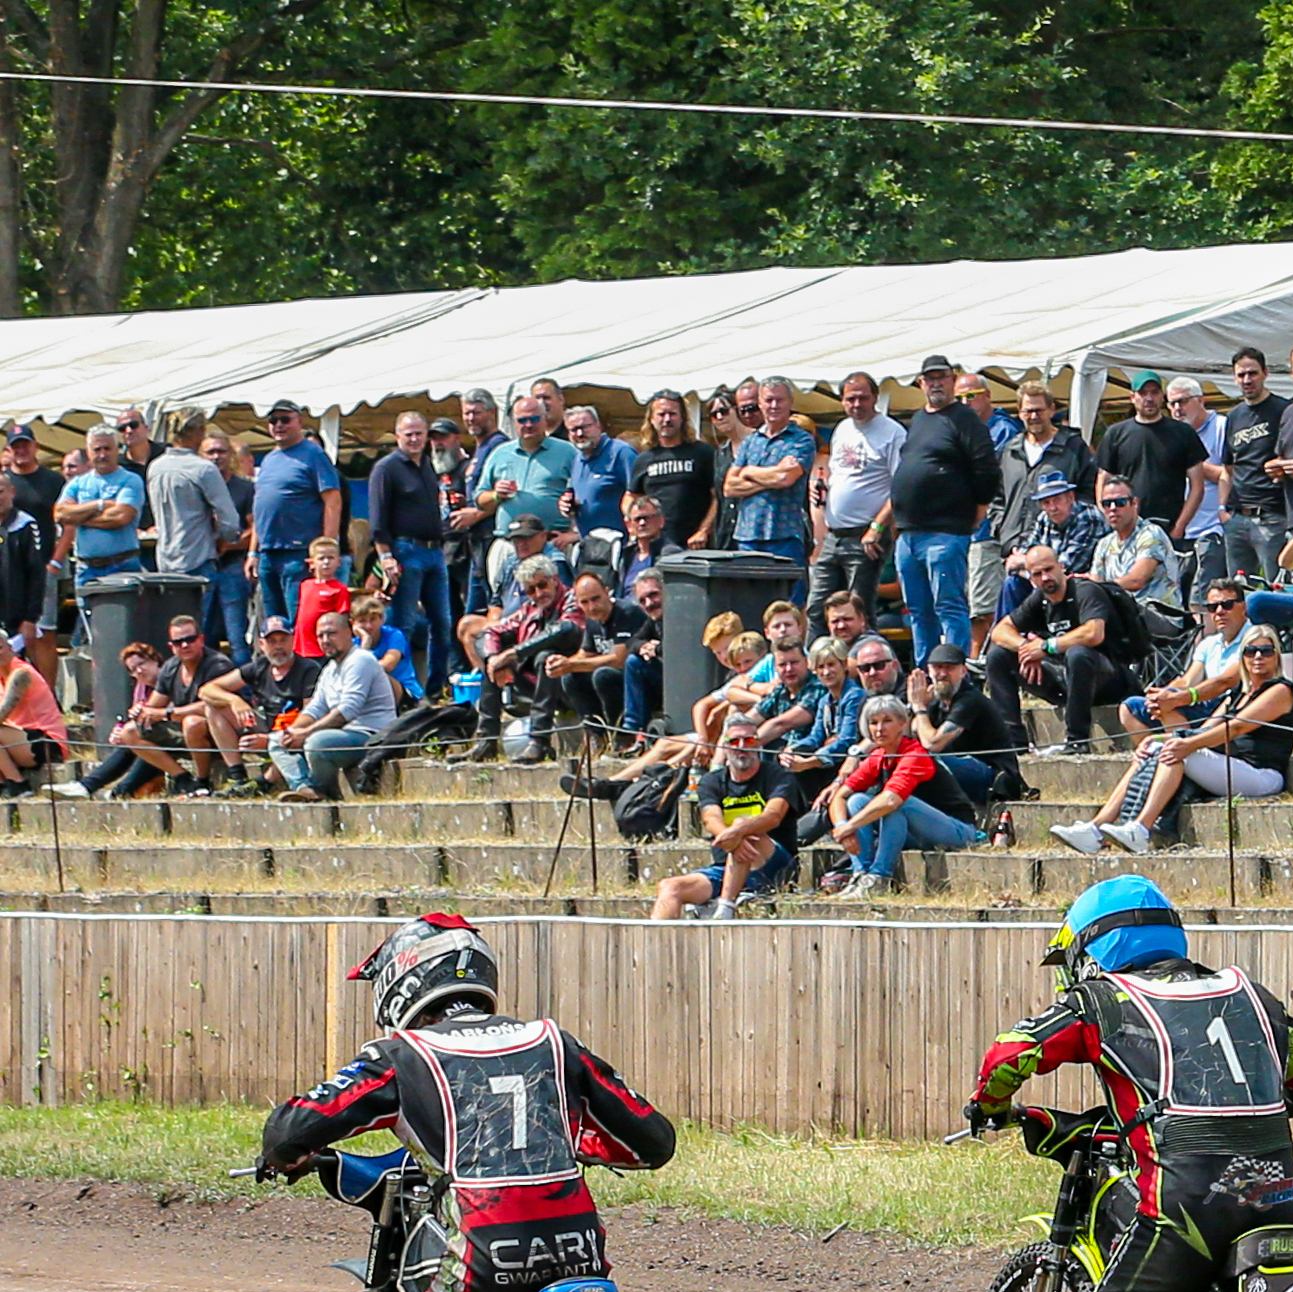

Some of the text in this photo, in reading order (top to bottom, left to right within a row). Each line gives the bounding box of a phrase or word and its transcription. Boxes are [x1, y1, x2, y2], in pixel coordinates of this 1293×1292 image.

[1206, 1016, 1247, 1084] 1
[488, 1074, 528, 1150] 7
[489, 1231, 589, 1269] CAR
